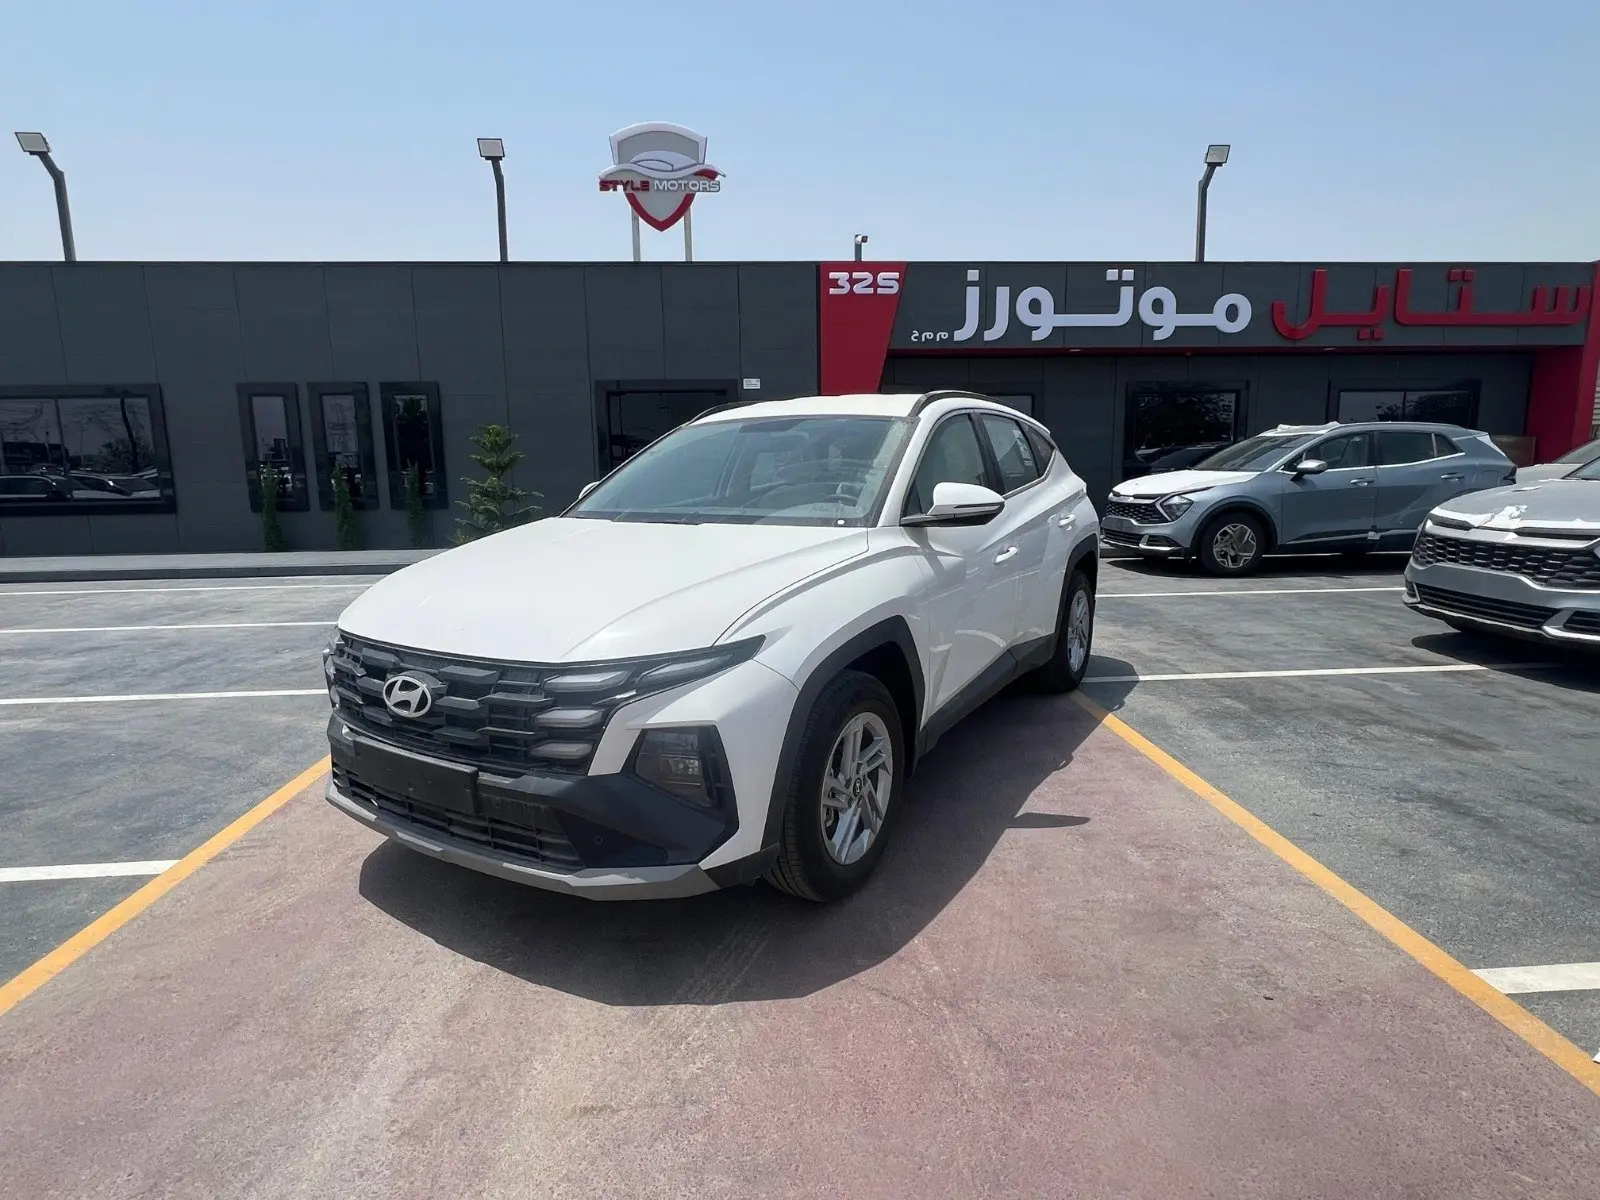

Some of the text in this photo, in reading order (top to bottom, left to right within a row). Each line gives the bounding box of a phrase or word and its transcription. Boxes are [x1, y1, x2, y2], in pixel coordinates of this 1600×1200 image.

[599, 180, 720, 192] STYLE MOTORS
[953, 268, 1252, 341] موتورز
[1271, 268, 1592, 341] ستايل
